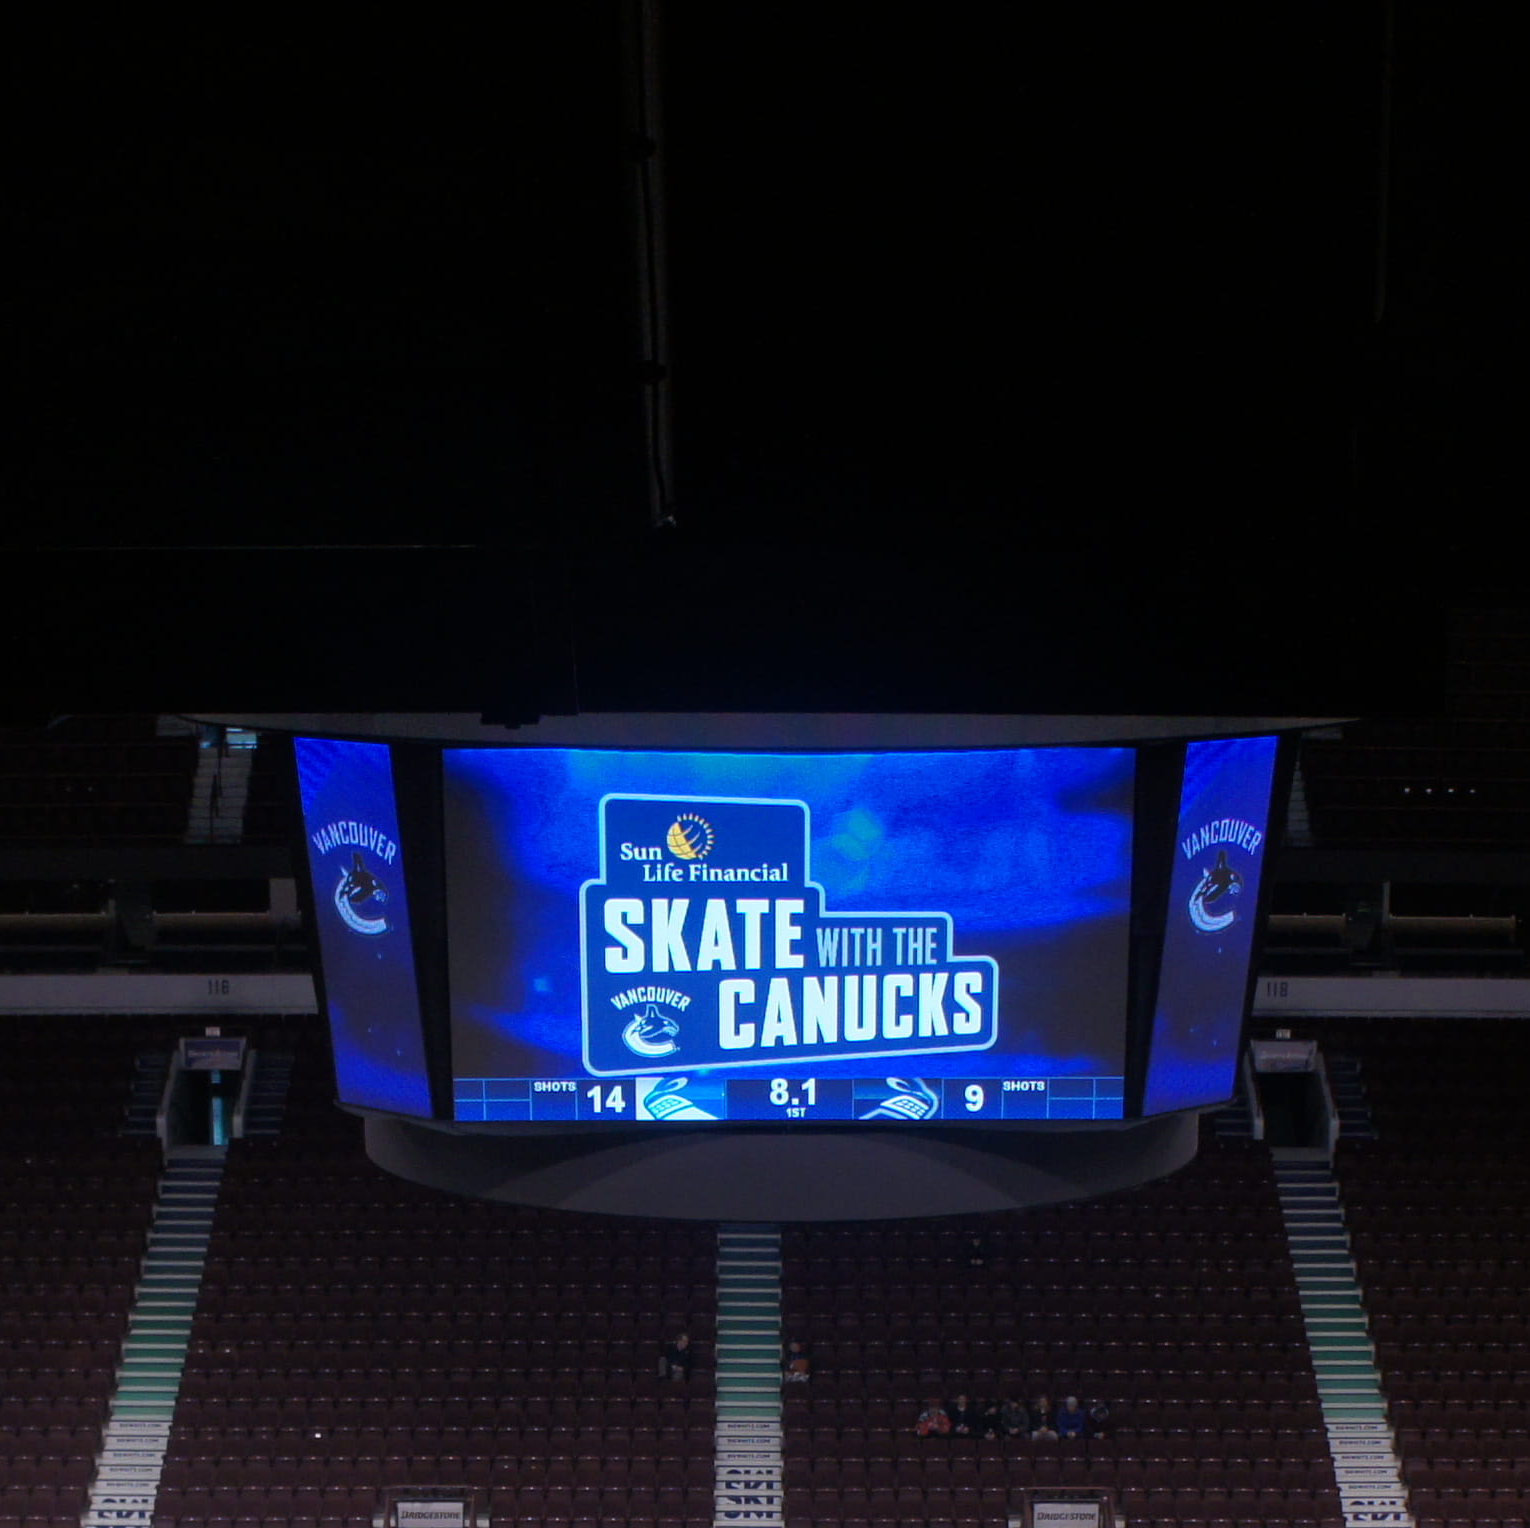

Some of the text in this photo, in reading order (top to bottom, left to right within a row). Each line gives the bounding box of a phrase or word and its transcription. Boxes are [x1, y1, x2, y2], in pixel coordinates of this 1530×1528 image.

[312, 820, 397, 866] VANCOUVER
[620, 842, 662, 861] Sun
[1181, 819, 1262, 860] VANCOUVER
[643, 862, 789, 882] Life Financial
[604, 897, 938, 974] SKATE WITH THE
[610, 985, 691, 1012] VANCOUVER
[718, 971, 983, 1050] CANUCKS
[534, 1081, 577, 1093] SHOTS
[586, 1085, 626, 1113] 14
[769, 1078, 817, 1106] 8.1
[964, 1085, 984, 1112] 9
[1002, 1080, 1046, 1092] SHOTS
[785, 1107, 807, 1119] 1ST
